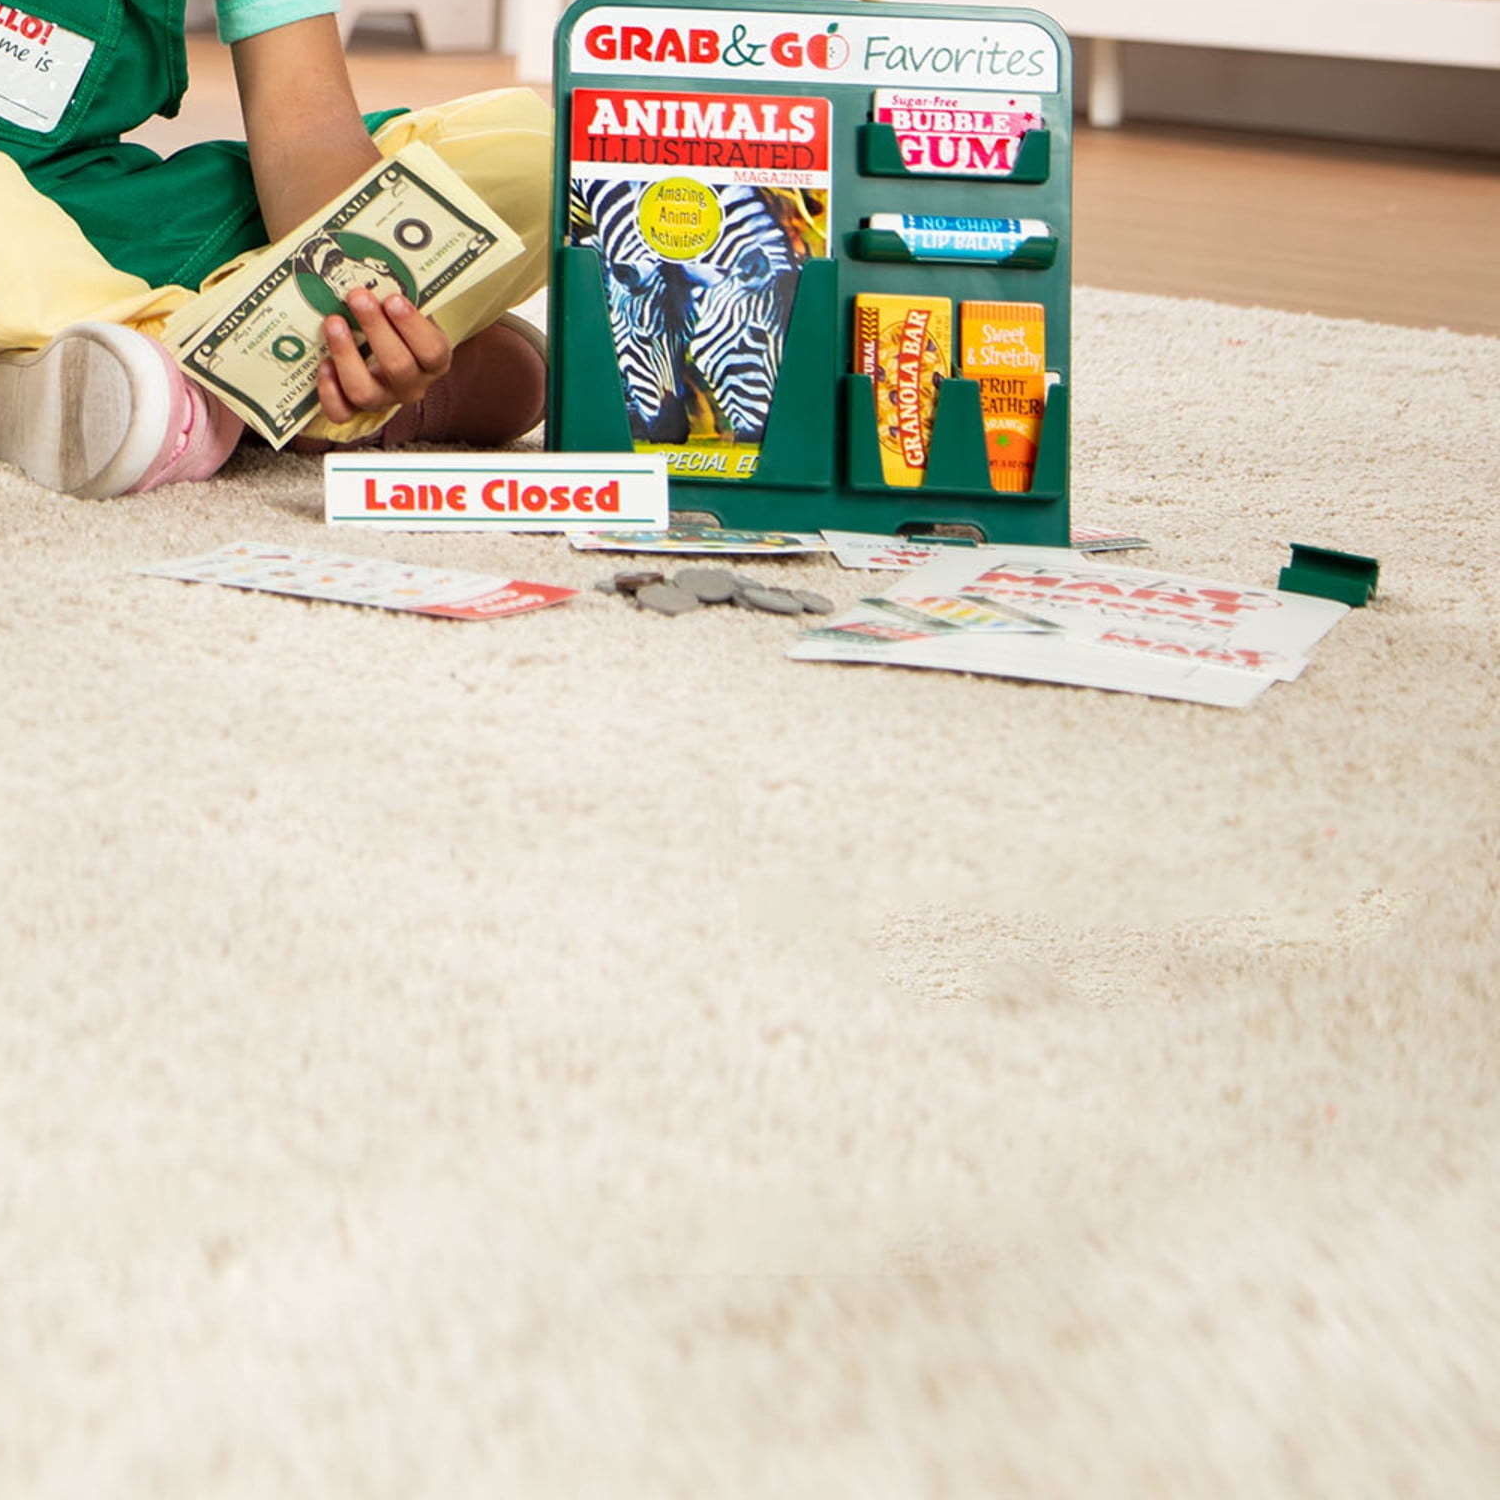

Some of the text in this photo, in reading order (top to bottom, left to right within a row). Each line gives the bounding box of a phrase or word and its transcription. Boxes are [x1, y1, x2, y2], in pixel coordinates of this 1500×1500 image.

[35, 51, 53, 73] is
[864, 36, 1045, 77] Favorites
[587, 98, 816, 144] ANIMALS
[891, 110, 1011, 134] BUBBLE
[587, 136, 816, 171] ILLUSTRATED
[897, 134, 1012, 171] GUM
[733, 171, 814, 186] MAGAZINE
[332, 192, 372, 228] FIVE
[922, 233, 1003, 251] LIP BALM
[216, 267, 290, 339] DOLLARS
[982, 324, 1026, 346] Sweet
[980, 347, 1043, 373] Stretchy
[899, 311, 928, 466] GRANOLA BAR
[979, 377, 1029, 396] FRUIT
[981, 397, 1043, 416] EATHER
[660, 451, 727, 473] PECIAL
[364, 478, 621, 513] Lane Closed
